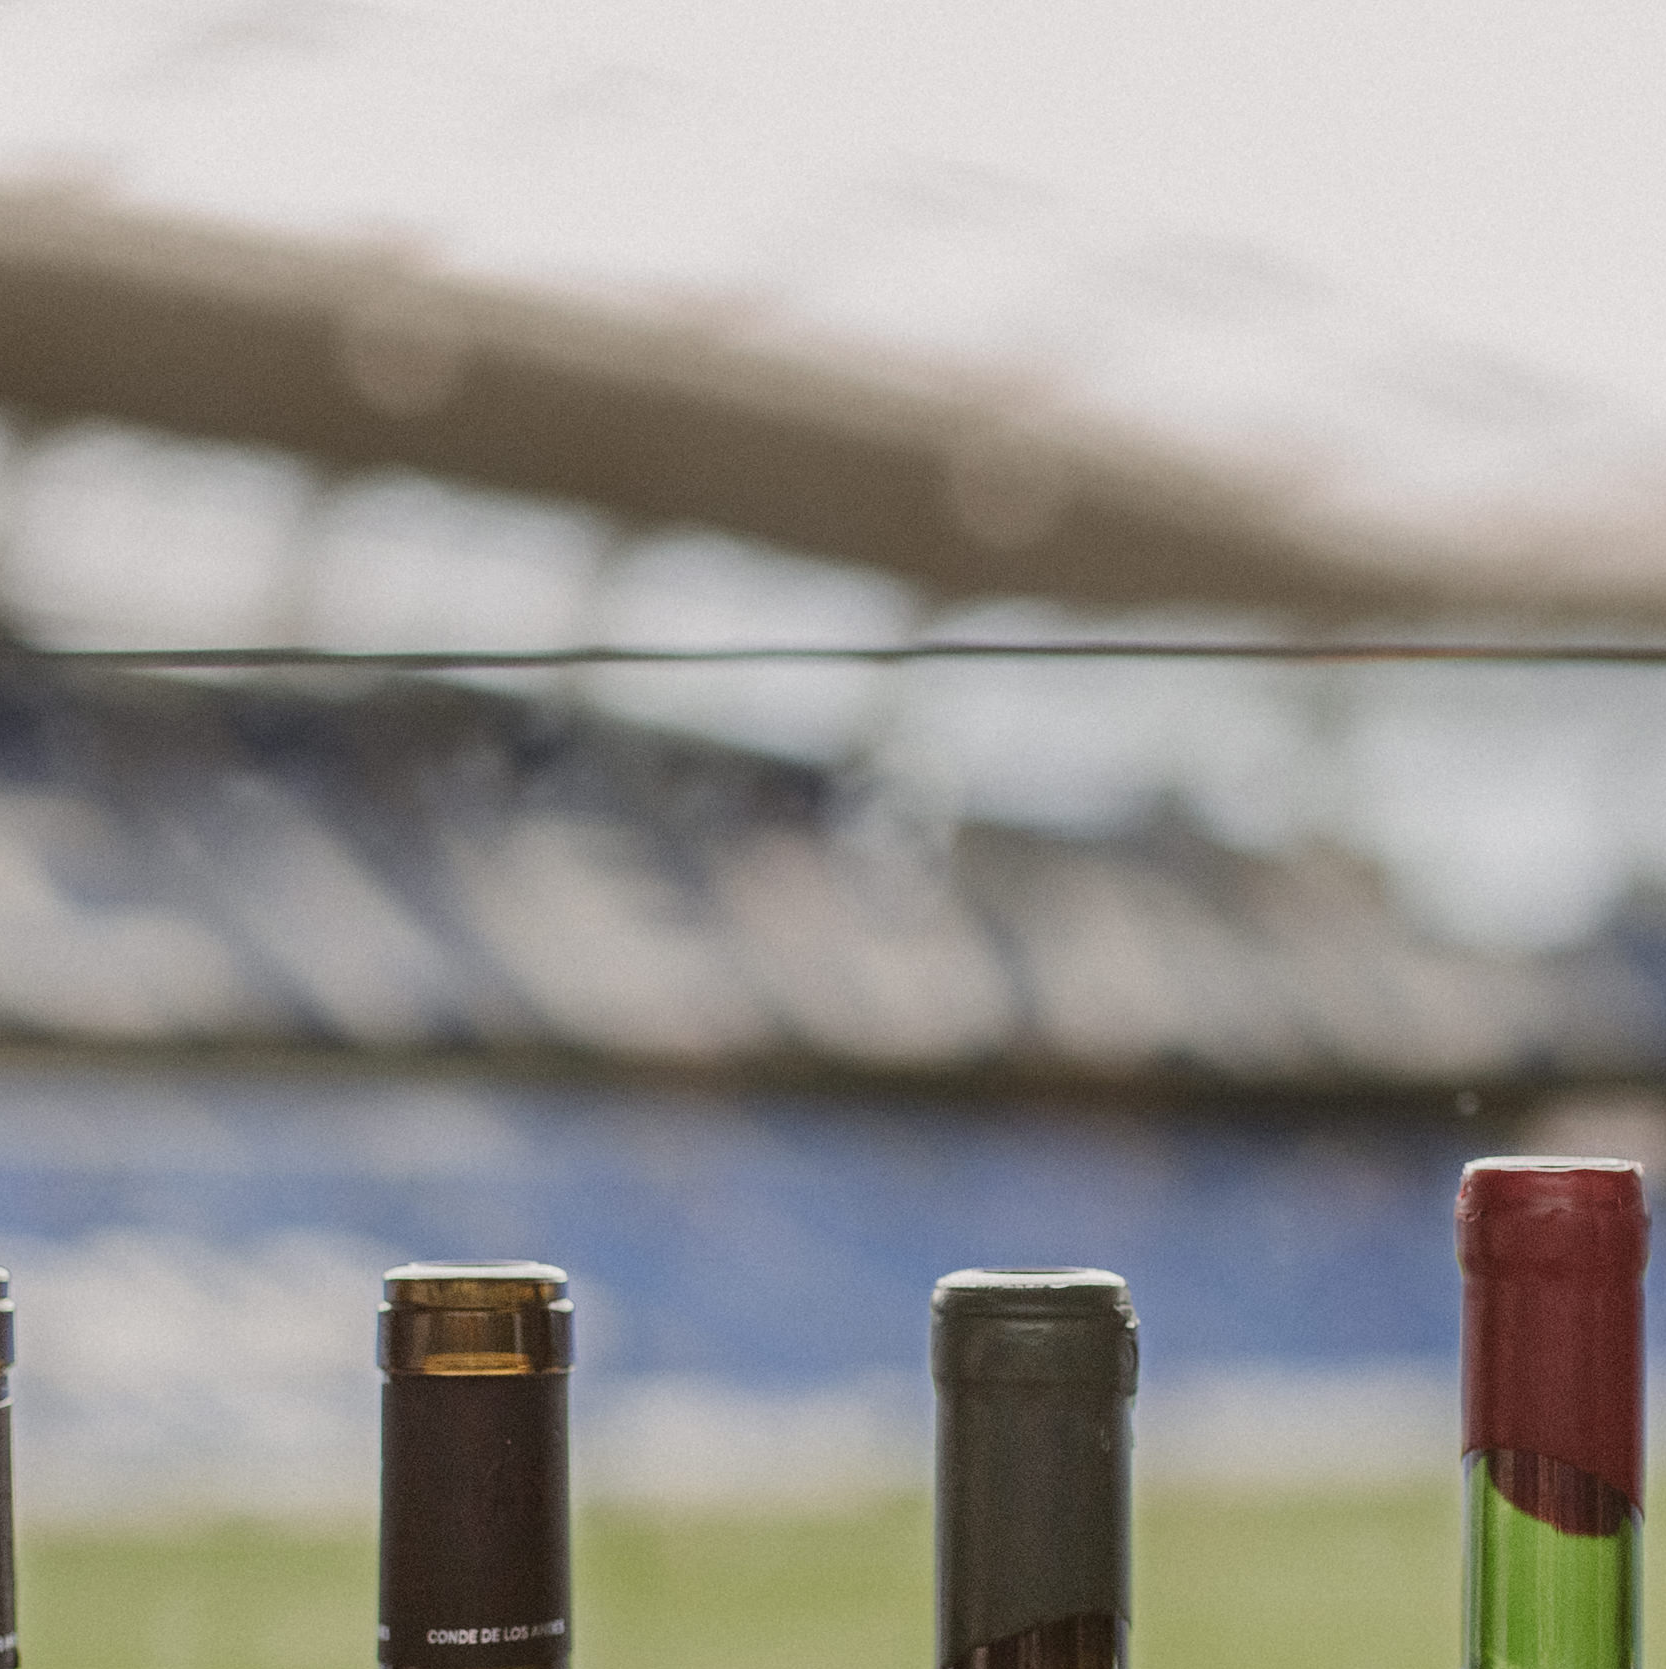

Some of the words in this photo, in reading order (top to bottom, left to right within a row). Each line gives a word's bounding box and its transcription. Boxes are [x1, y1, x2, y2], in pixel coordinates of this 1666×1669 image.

[427, 1628, 477, 1645] CONDE
[480, 1627, 500, 1644] DE
[504, 1625, 528, 1643] LOS
